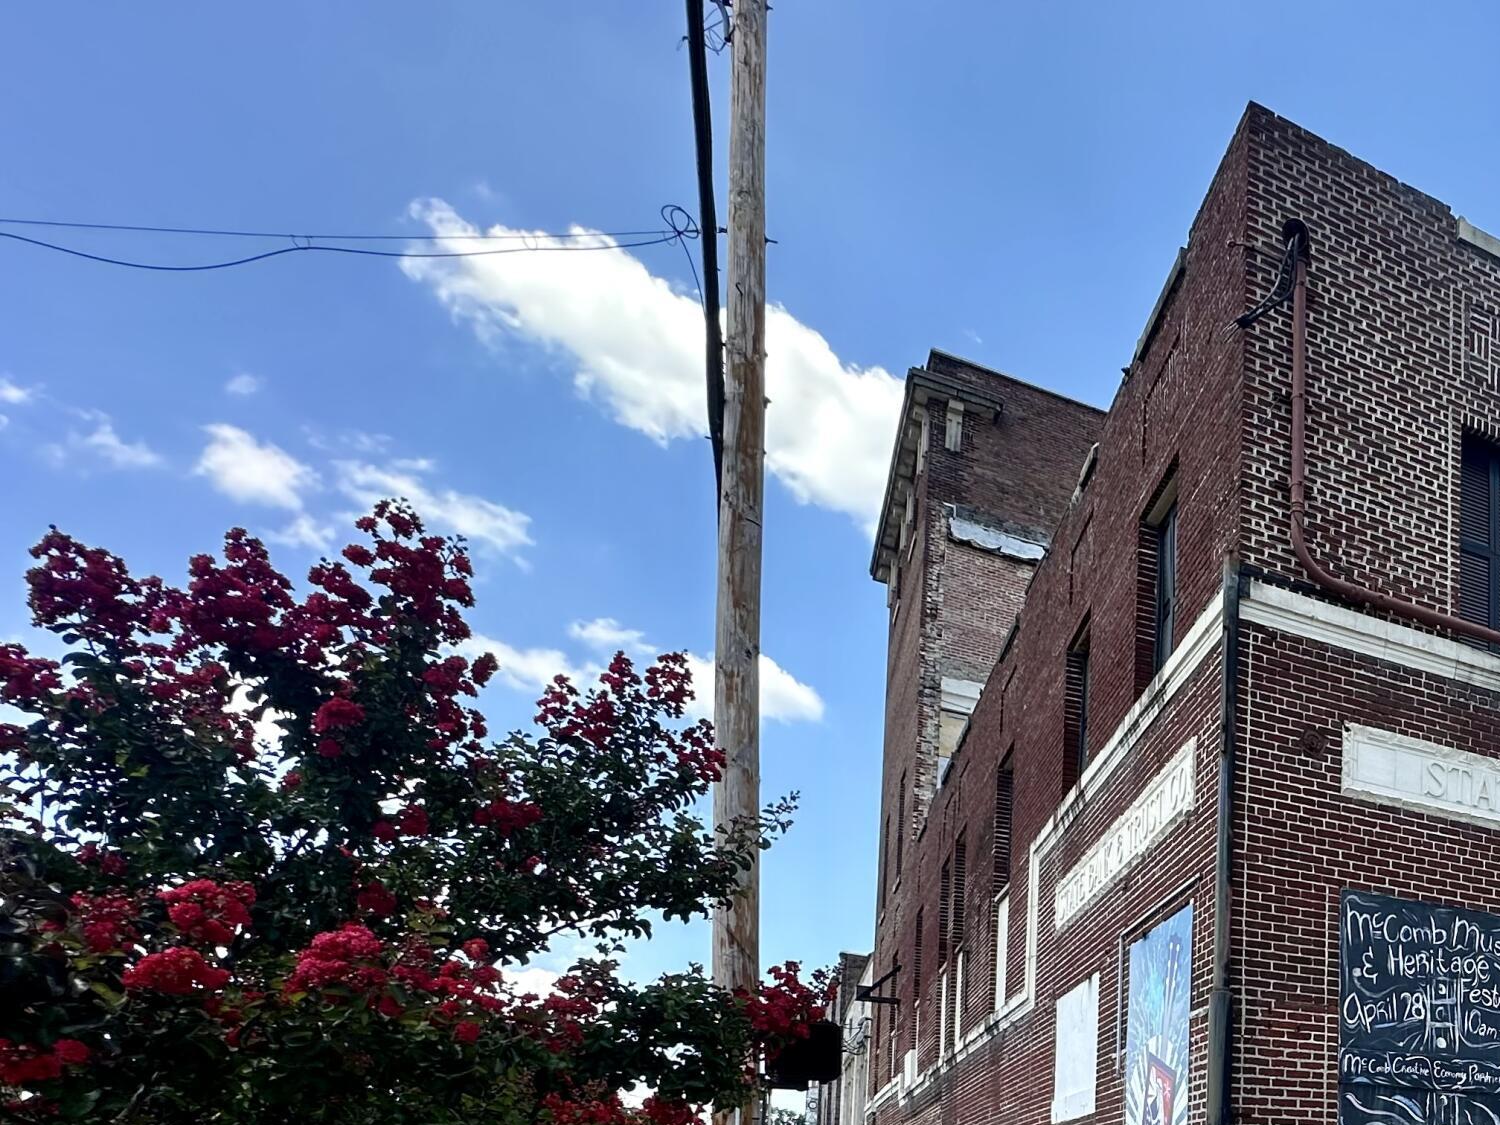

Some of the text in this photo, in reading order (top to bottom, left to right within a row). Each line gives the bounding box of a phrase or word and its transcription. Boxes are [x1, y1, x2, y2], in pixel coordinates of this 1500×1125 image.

[1127, 789, 1165, 851] TRUST
[1346, 902, 1448, 947] McComb
[1400, 991, 1426, 1022] 28
[1433, 1060, 1468, 1085] Economy
